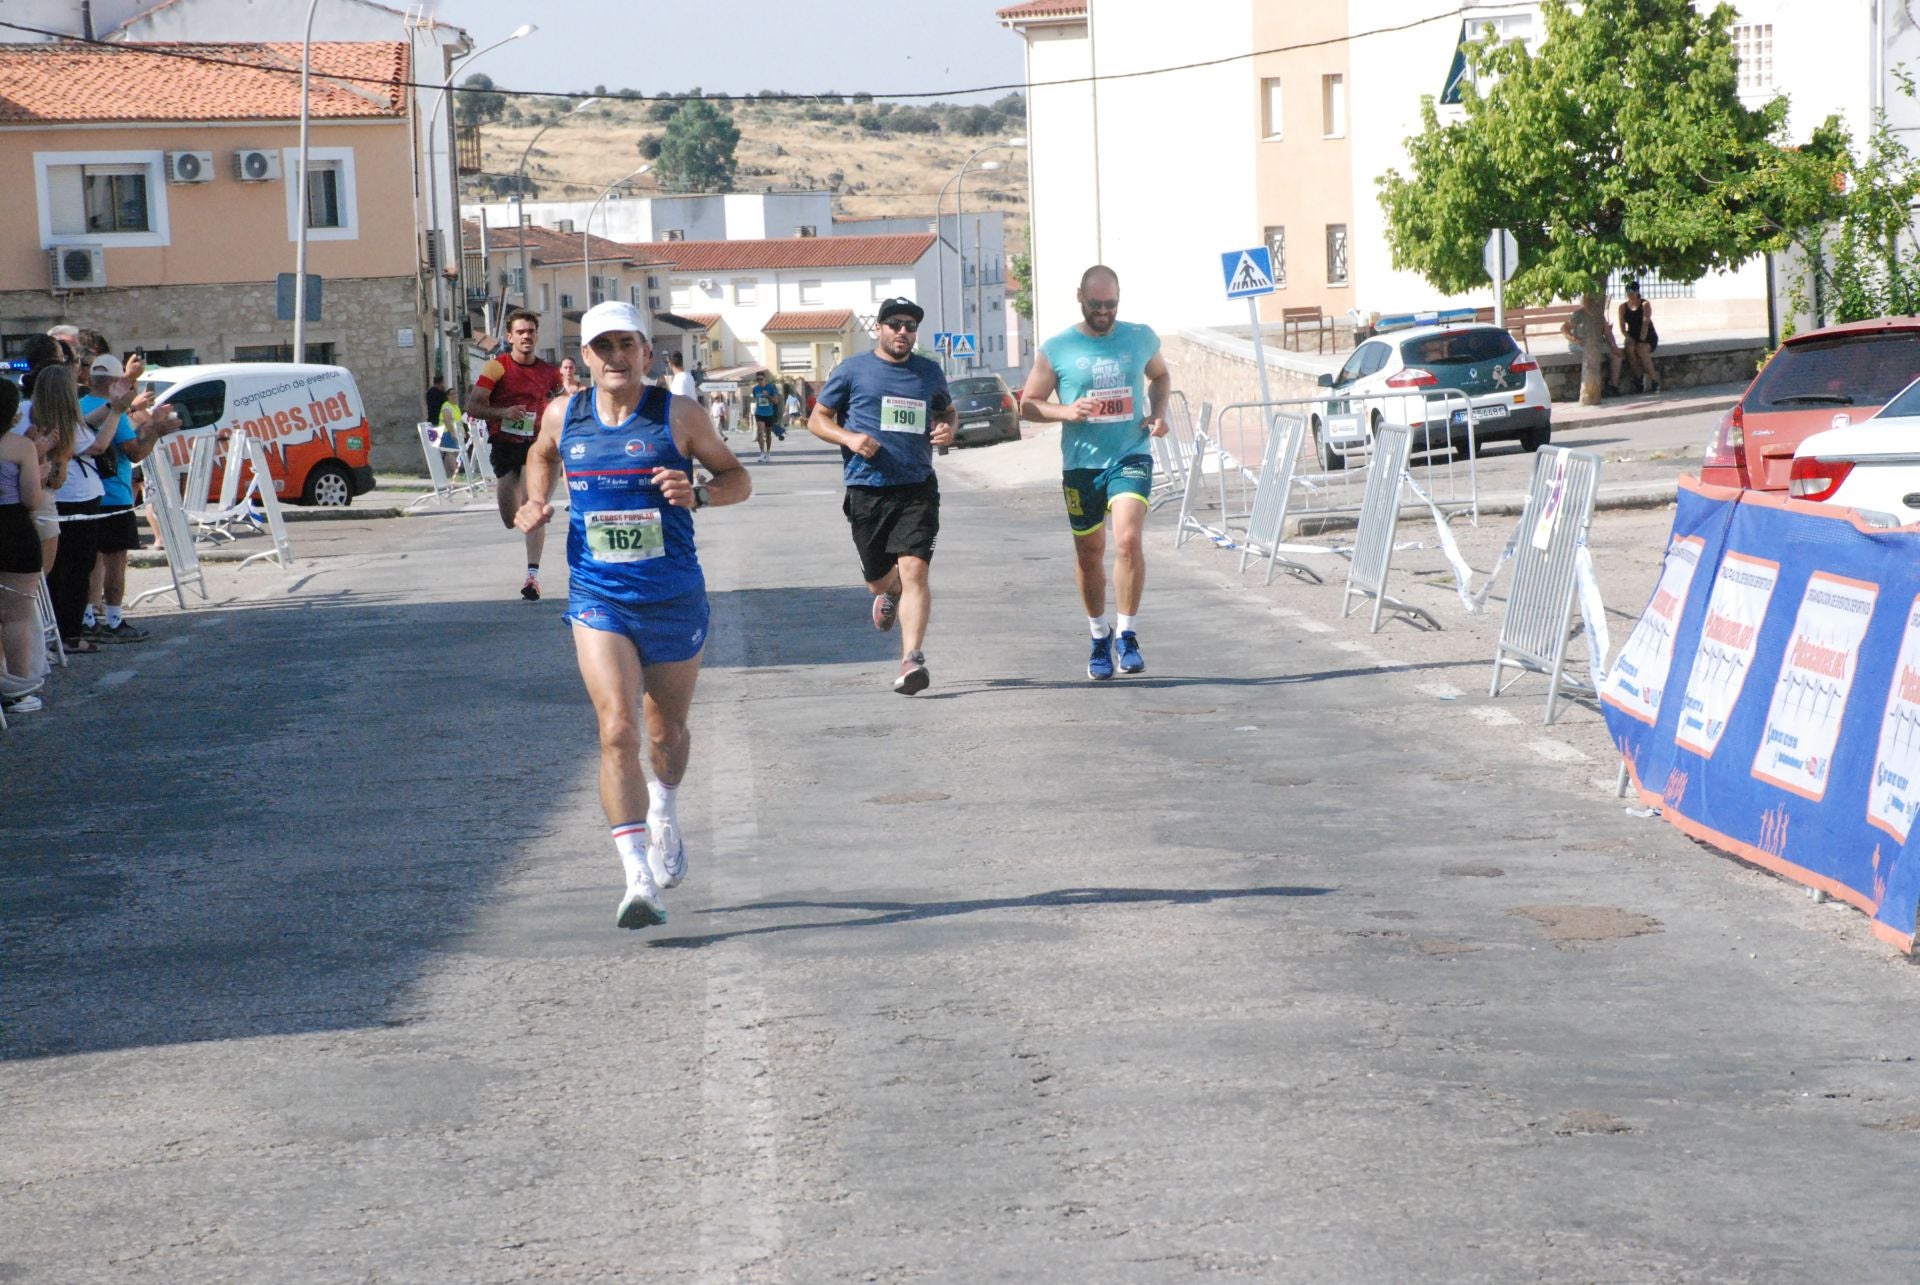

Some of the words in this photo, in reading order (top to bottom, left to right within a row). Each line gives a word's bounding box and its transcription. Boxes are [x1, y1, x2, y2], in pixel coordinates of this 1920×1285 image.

[232, 382, 292, 407] organización
[292, 379, 306, 389] de
[306, 369, 341, 386] eventos
[1099, 399, 1124, 415] 280
[892, 410, 916, 425] 190
[605, 529, 643, 550] 162
